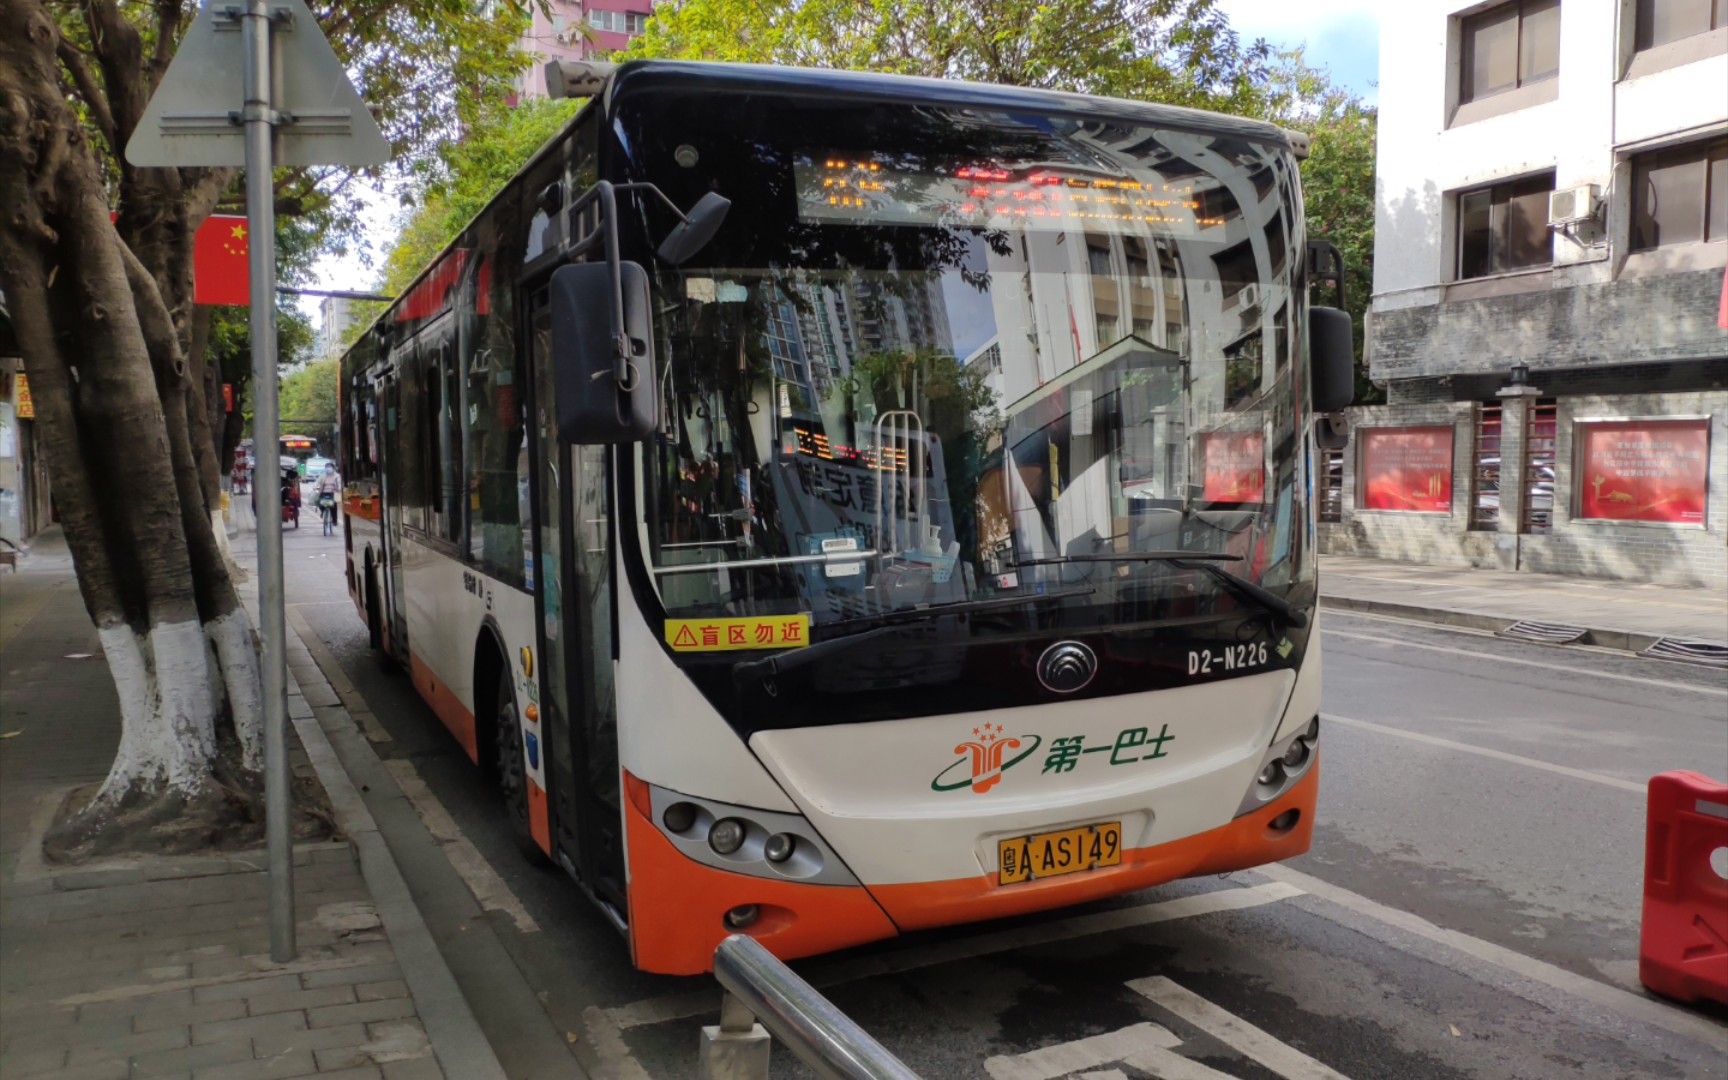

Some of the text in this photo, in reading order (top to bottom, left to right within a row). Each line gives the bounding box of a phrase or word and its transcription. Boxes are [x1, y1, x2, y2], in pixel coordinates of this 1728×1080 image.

[18, 376, 34, 416] 五金店
[699, 621, 802, 647] 盲区勿近
[1188, 641, 1268, 675] D2-N226
[1041, 723, 1176, 775] 第一巴士
